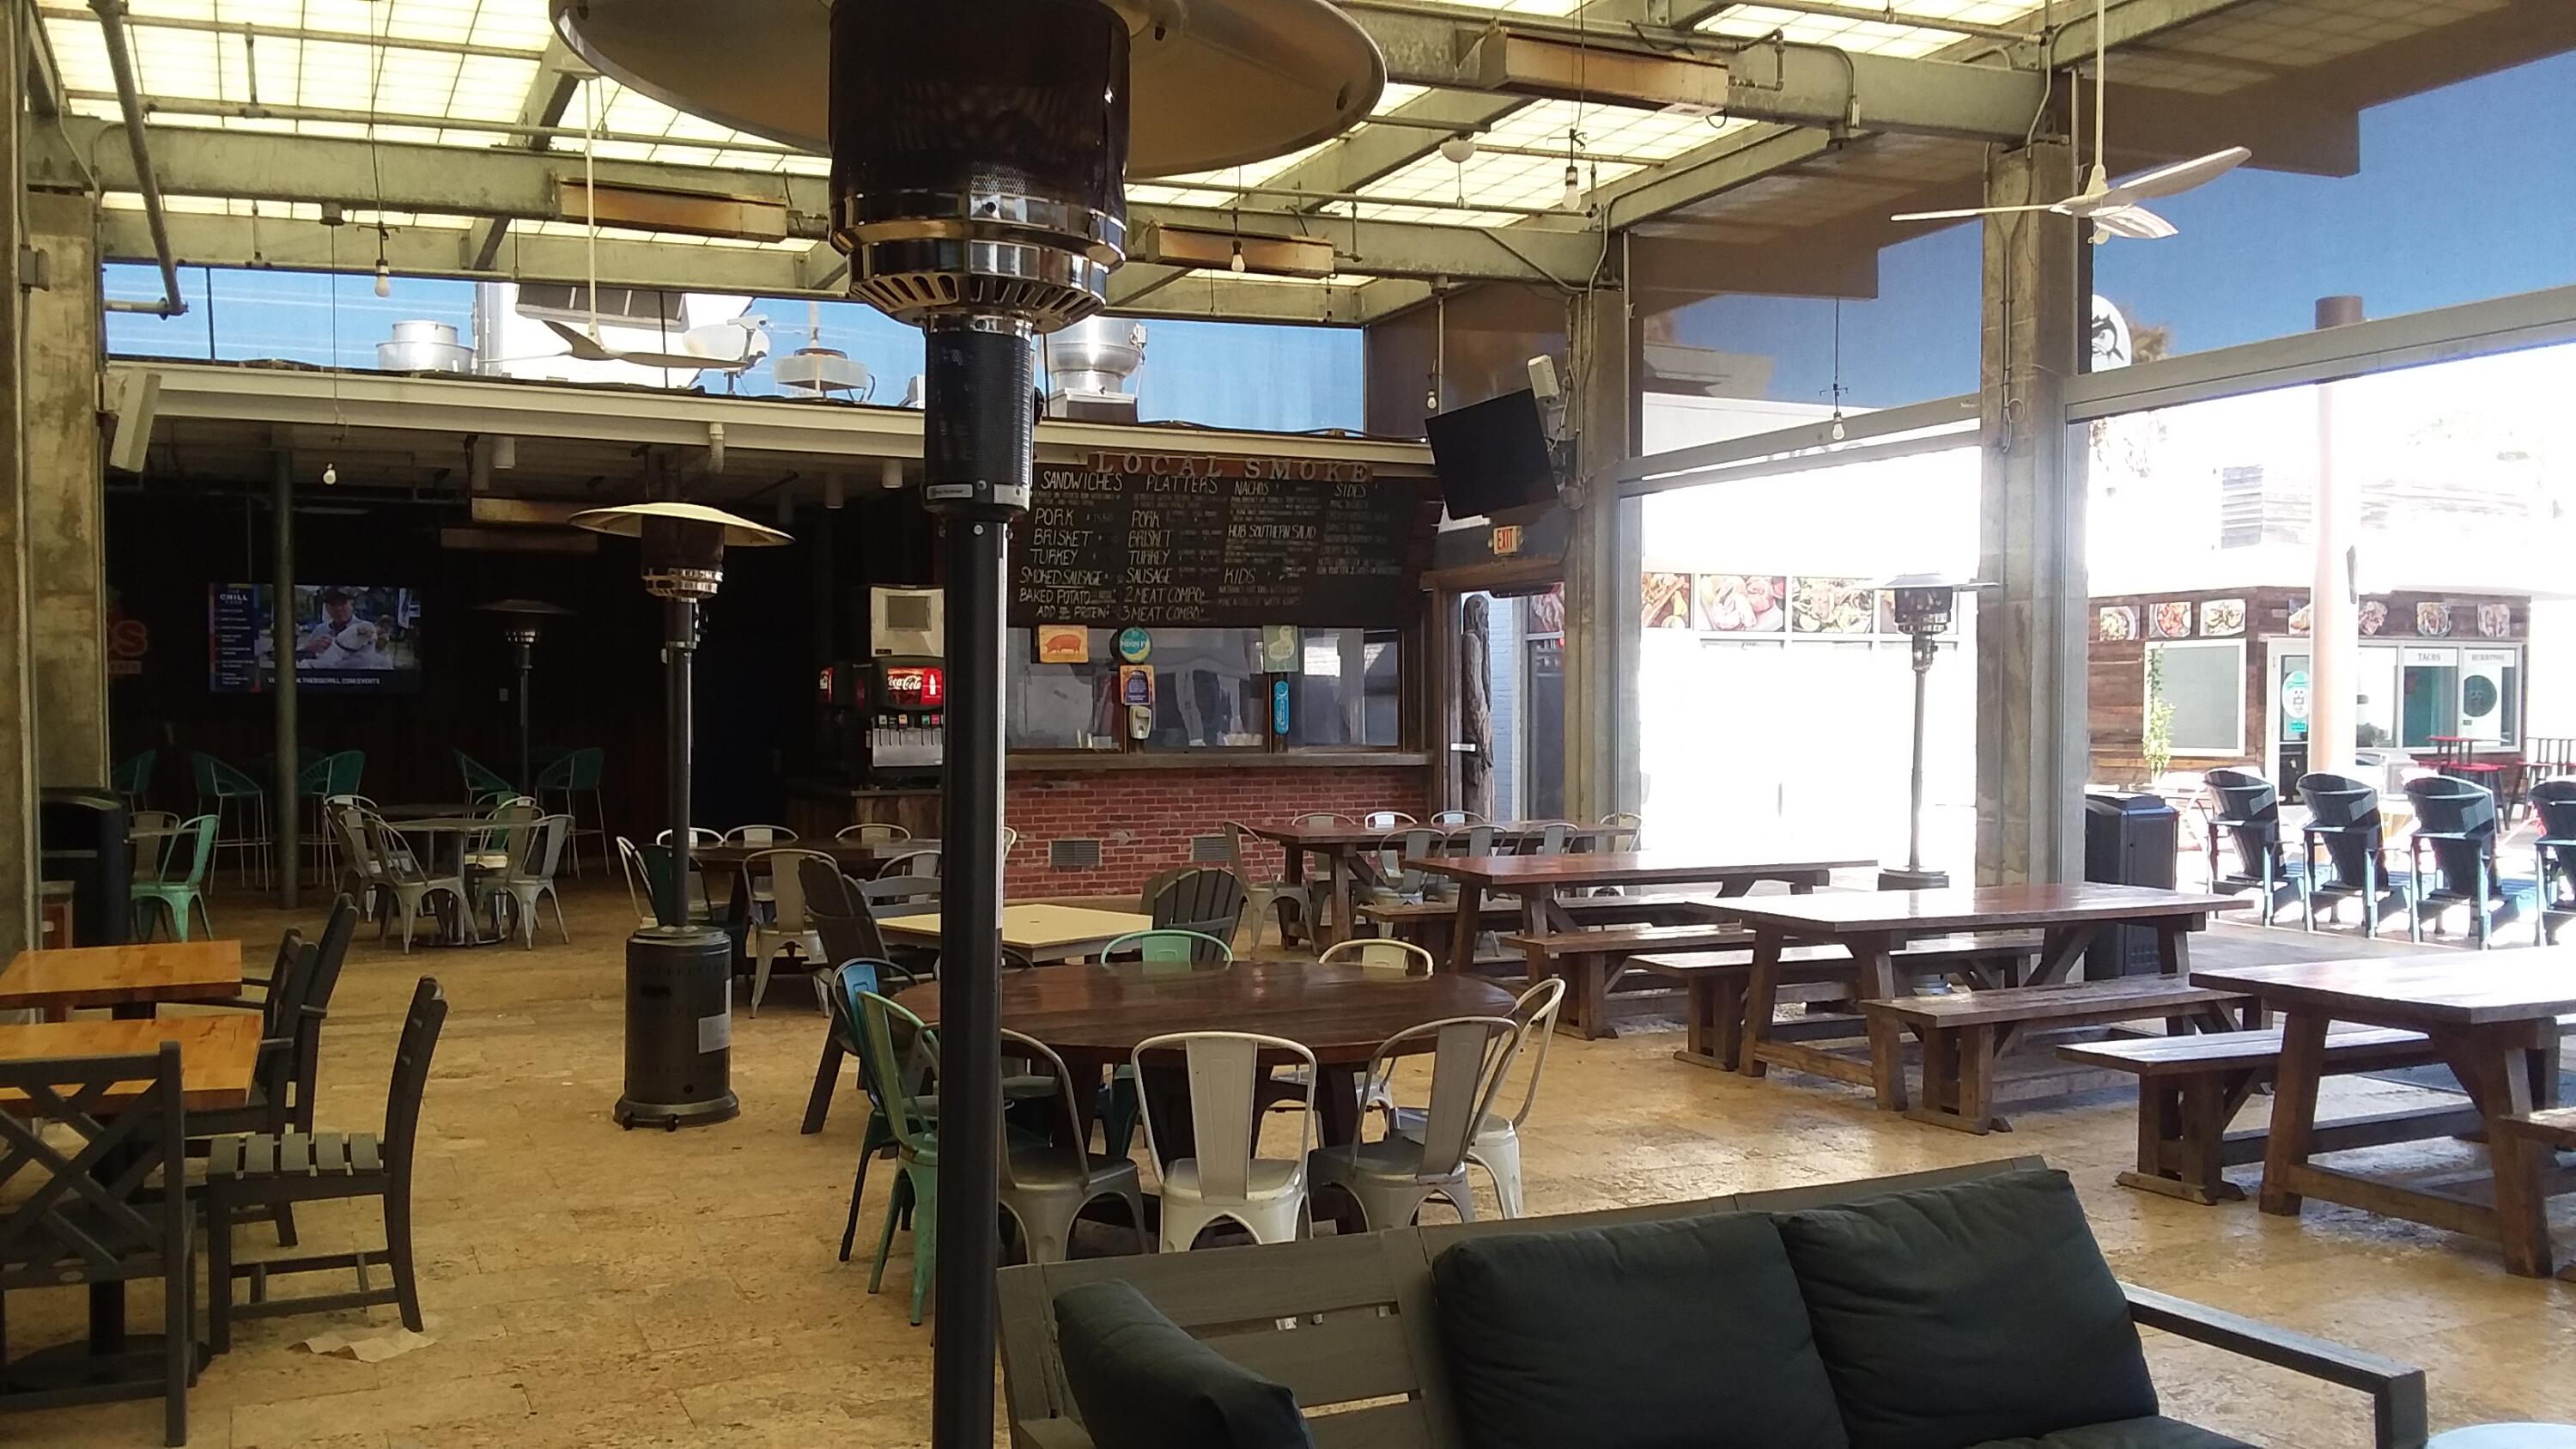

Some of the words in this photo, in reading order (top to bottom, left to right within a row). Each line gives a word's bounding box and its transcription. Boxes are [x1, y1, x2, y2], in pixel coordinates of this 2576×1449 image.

[1096, 451, 1224, 478] LOCAL
[1244, 458, 1370, 483] SMOKE
[1040, 471, 1124, 491] SANDWICHES
[1145, 474, 1218, 495] PLATTERS
[1234, 480, 1269, 496] NACHOS
[1334, 483, 1367, 498] SIDES
[1034, 507, 1075, 527] PORK
[1131, 510, 1161, 529] PORK
[1033, 529, 1095, 548] BRISKET
[1128, 529, 1174, 548] BRISKET
[1228, 524, 1247, 539] HUB
[1249, 524, 1291, 539] SOUTHERN
[1291, 525, 1317, 540] SALAD
[1497, 528, 1515, 551] EXIT
[1030, 548, 1078, 566] TURKEY
[1127, 550, 1171, 566] TURKEY
[1018, 566, 1062, 586] SMOKED
[1061, 569, 1103, 587] SAUSAGE
[1126, 567, 1174, 585] SAUSAGE
[1224, 567, 1257, 585] KIDS
[1019, 588, 1054, 604] BAKED
[1057, 589, 1091, 605] POTATO
[1125, 586, 1134, 604] 2
[1133, 587, 1164, 605] MEAT
[1036, 605, 1056, 618] ADD
[1120, 605, 1131, 621] 3
[1131, 606, 1164, 622] MEAT
[2418, 653, 2441, 661] TACOS
